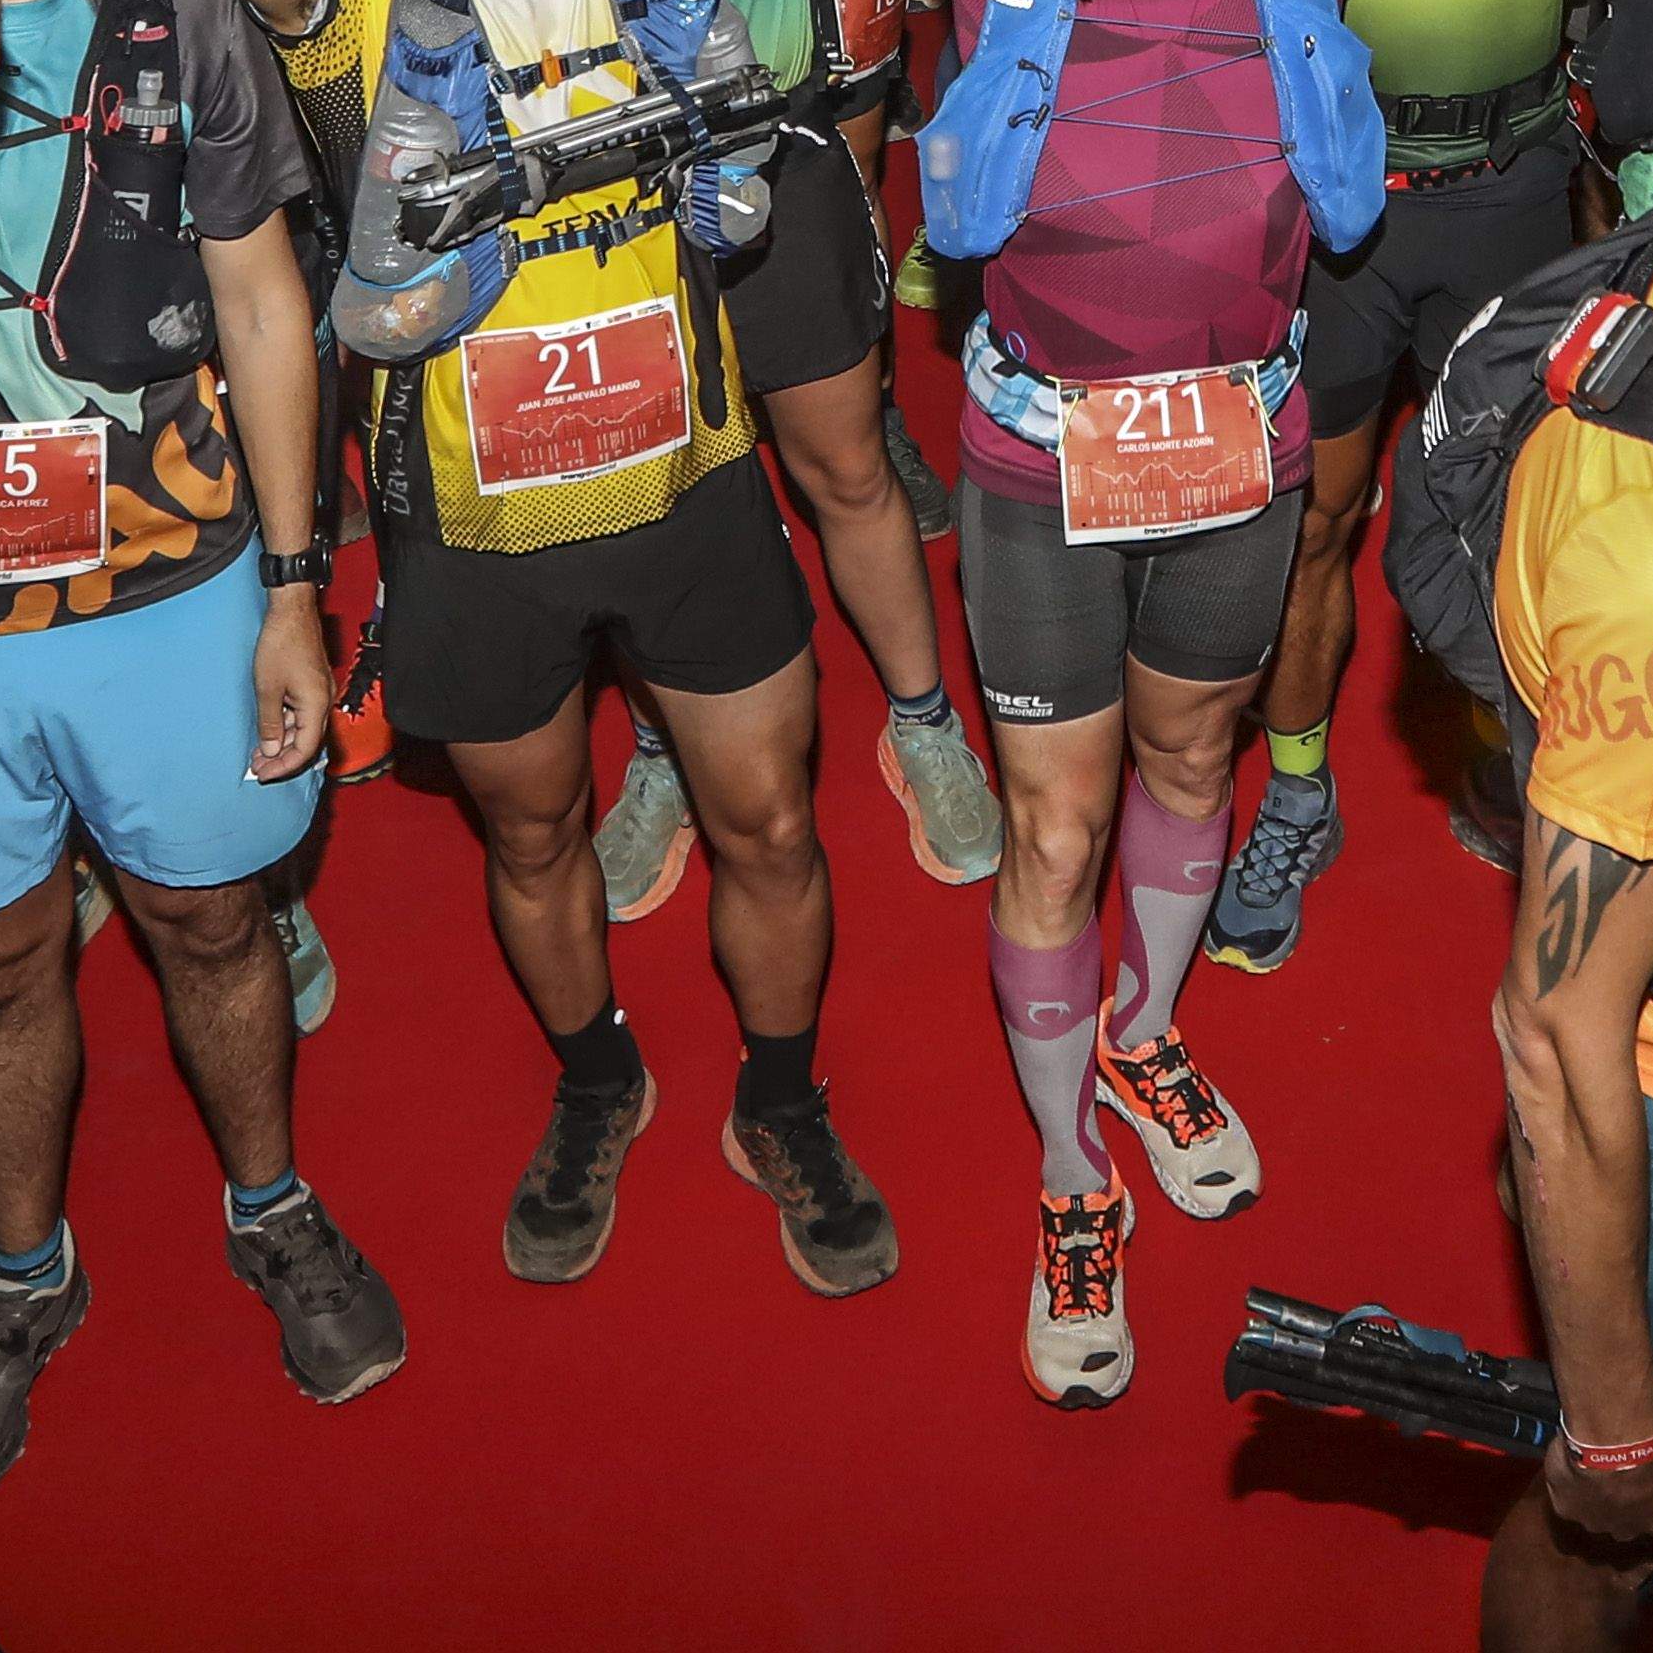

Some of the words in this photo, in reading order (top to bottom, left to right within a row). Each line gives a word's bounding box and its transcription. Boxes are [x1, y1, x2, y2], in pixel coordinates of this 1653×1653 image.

[538, 333, 604, 394] 21
[516, 401, 542, 413] JUAN
[542, 396, 566, 409] JOSE
[566, 388, 606, 405] AREVALO
[607, 379, 640, 395] MANSO
[1112, 382, 1208, 442] 211
[1116, 442, 1151, 454] CARLOS
[1152, 440, 1182, 452] MORTE
[1183, 435, 1214, 449] AZORÍN
[16, 498, 49, 508] PEREZ
